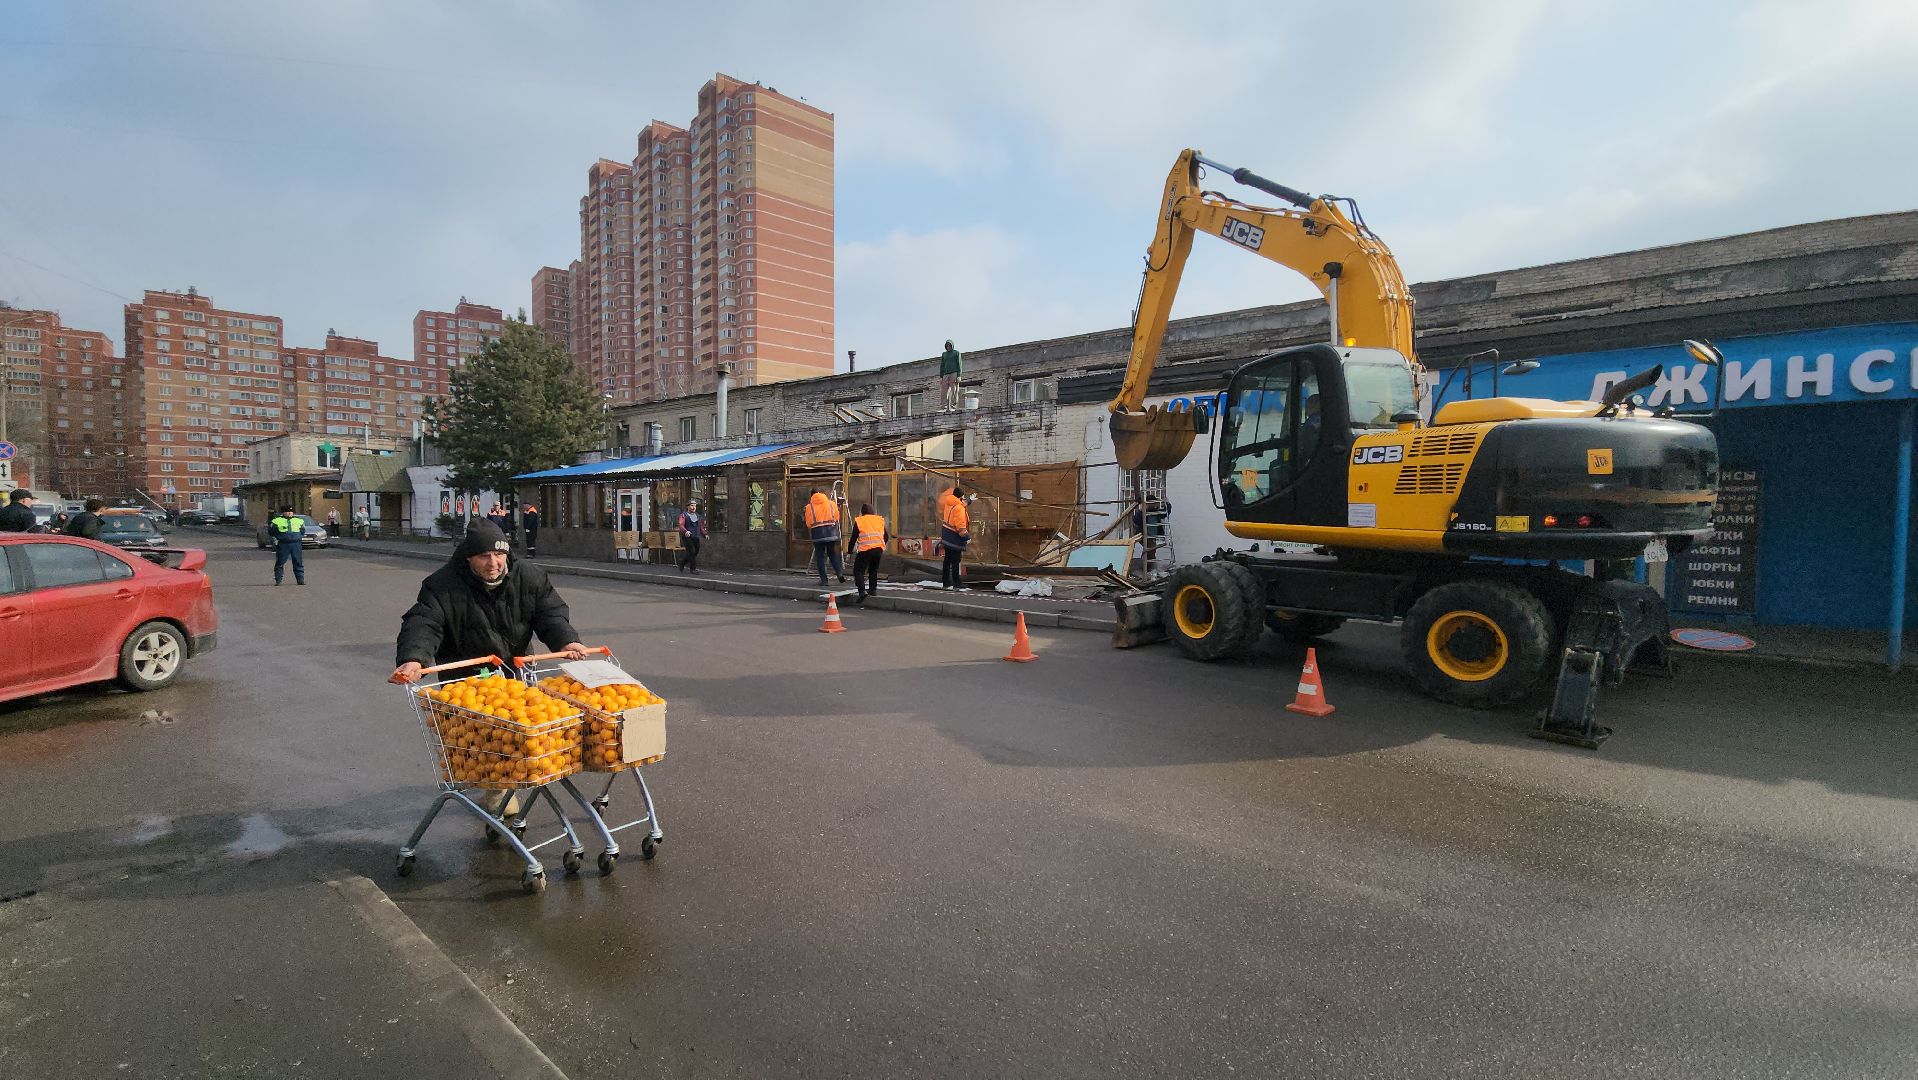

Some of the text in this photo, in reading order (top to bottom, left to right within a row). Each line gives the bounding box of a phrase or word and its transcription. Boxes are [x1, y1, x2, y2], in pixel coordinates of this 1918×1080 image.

[1222, 218, 1264, 249] JCB
[1589, 347, 1918, 407] ДЖИНС
[1354, 445, 1403, 464] JCB
[1688, 562, 1741, 573] ШОРТЫ
[1692, 579, 1735, 589] ЮБКИ
[1687, 595, 1738, 606] РЕМНИ
